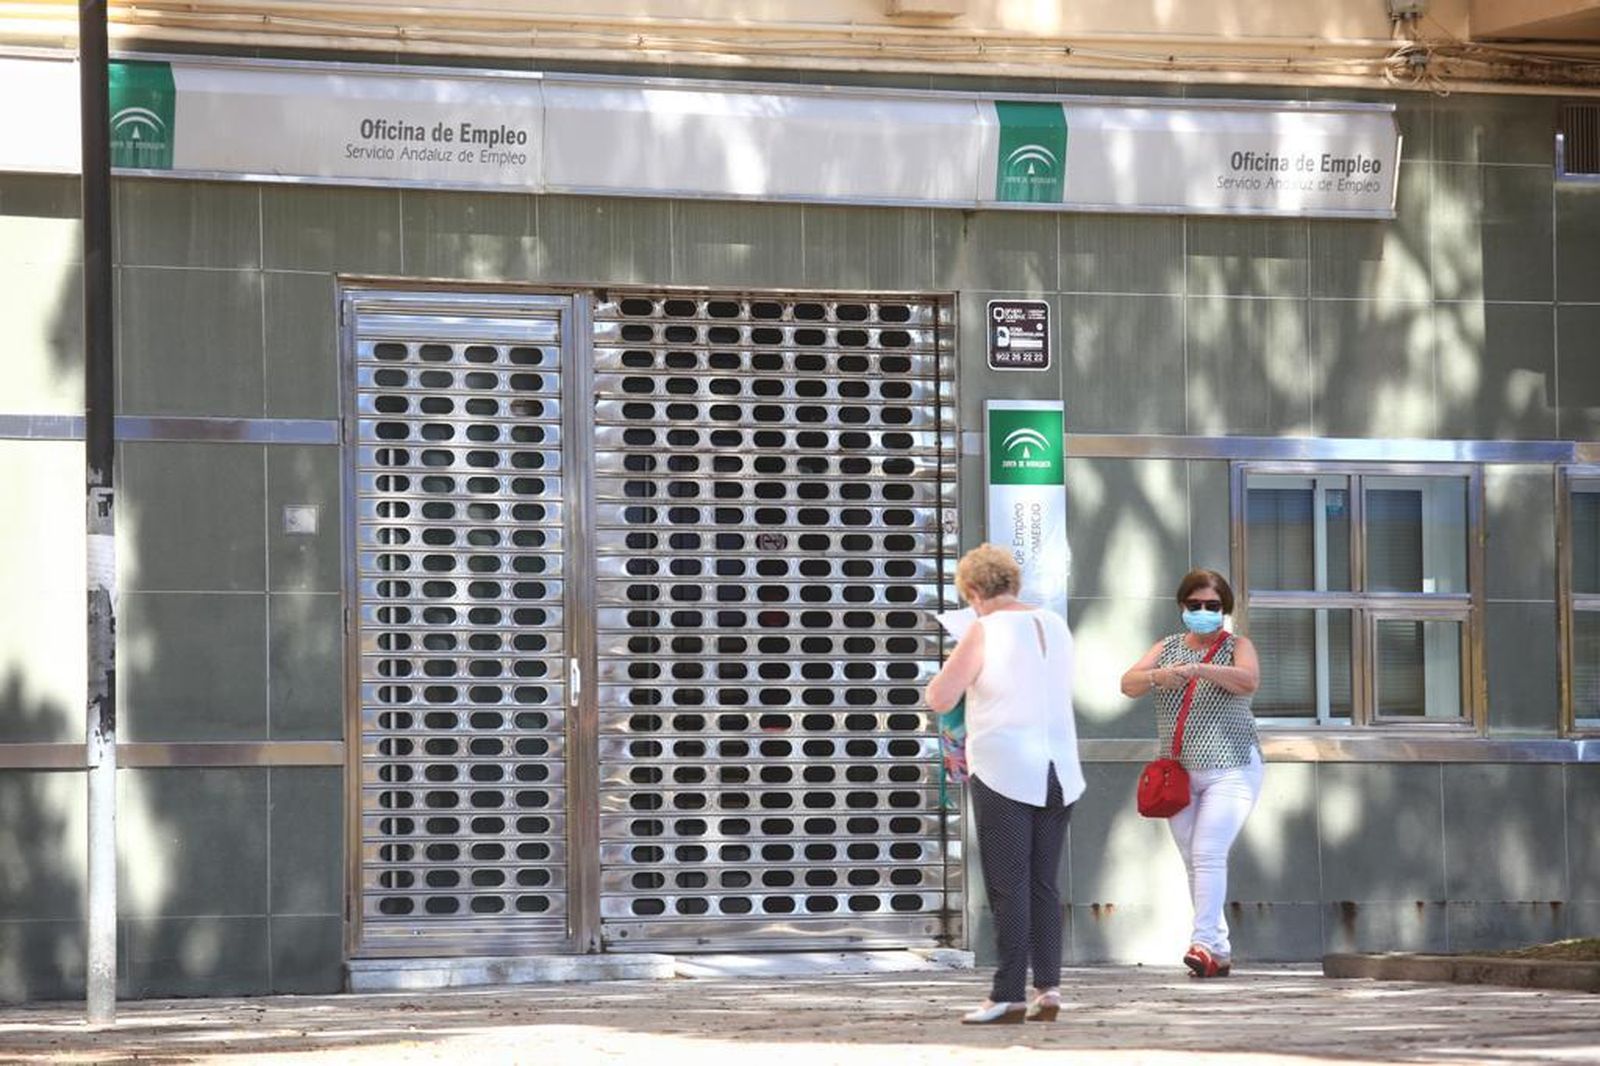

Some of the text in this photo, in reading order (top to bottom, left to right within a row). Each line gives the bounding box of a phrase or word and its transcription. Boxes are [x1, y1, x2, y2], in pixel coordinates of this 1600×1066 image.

[360, 118, 527, 148] Oficina de Empleo
[345, 143, 527, 167] Servicio Andaluz de Empleo
[1231, 151, 1381, 177] Oficina de Empleo
[1216, 175, 1381, 195] Servicio Anuz de Empleo
[1013, 503, 1026, 565] de Empleo
[1031, 503, 1041, 561] OMERCIO
